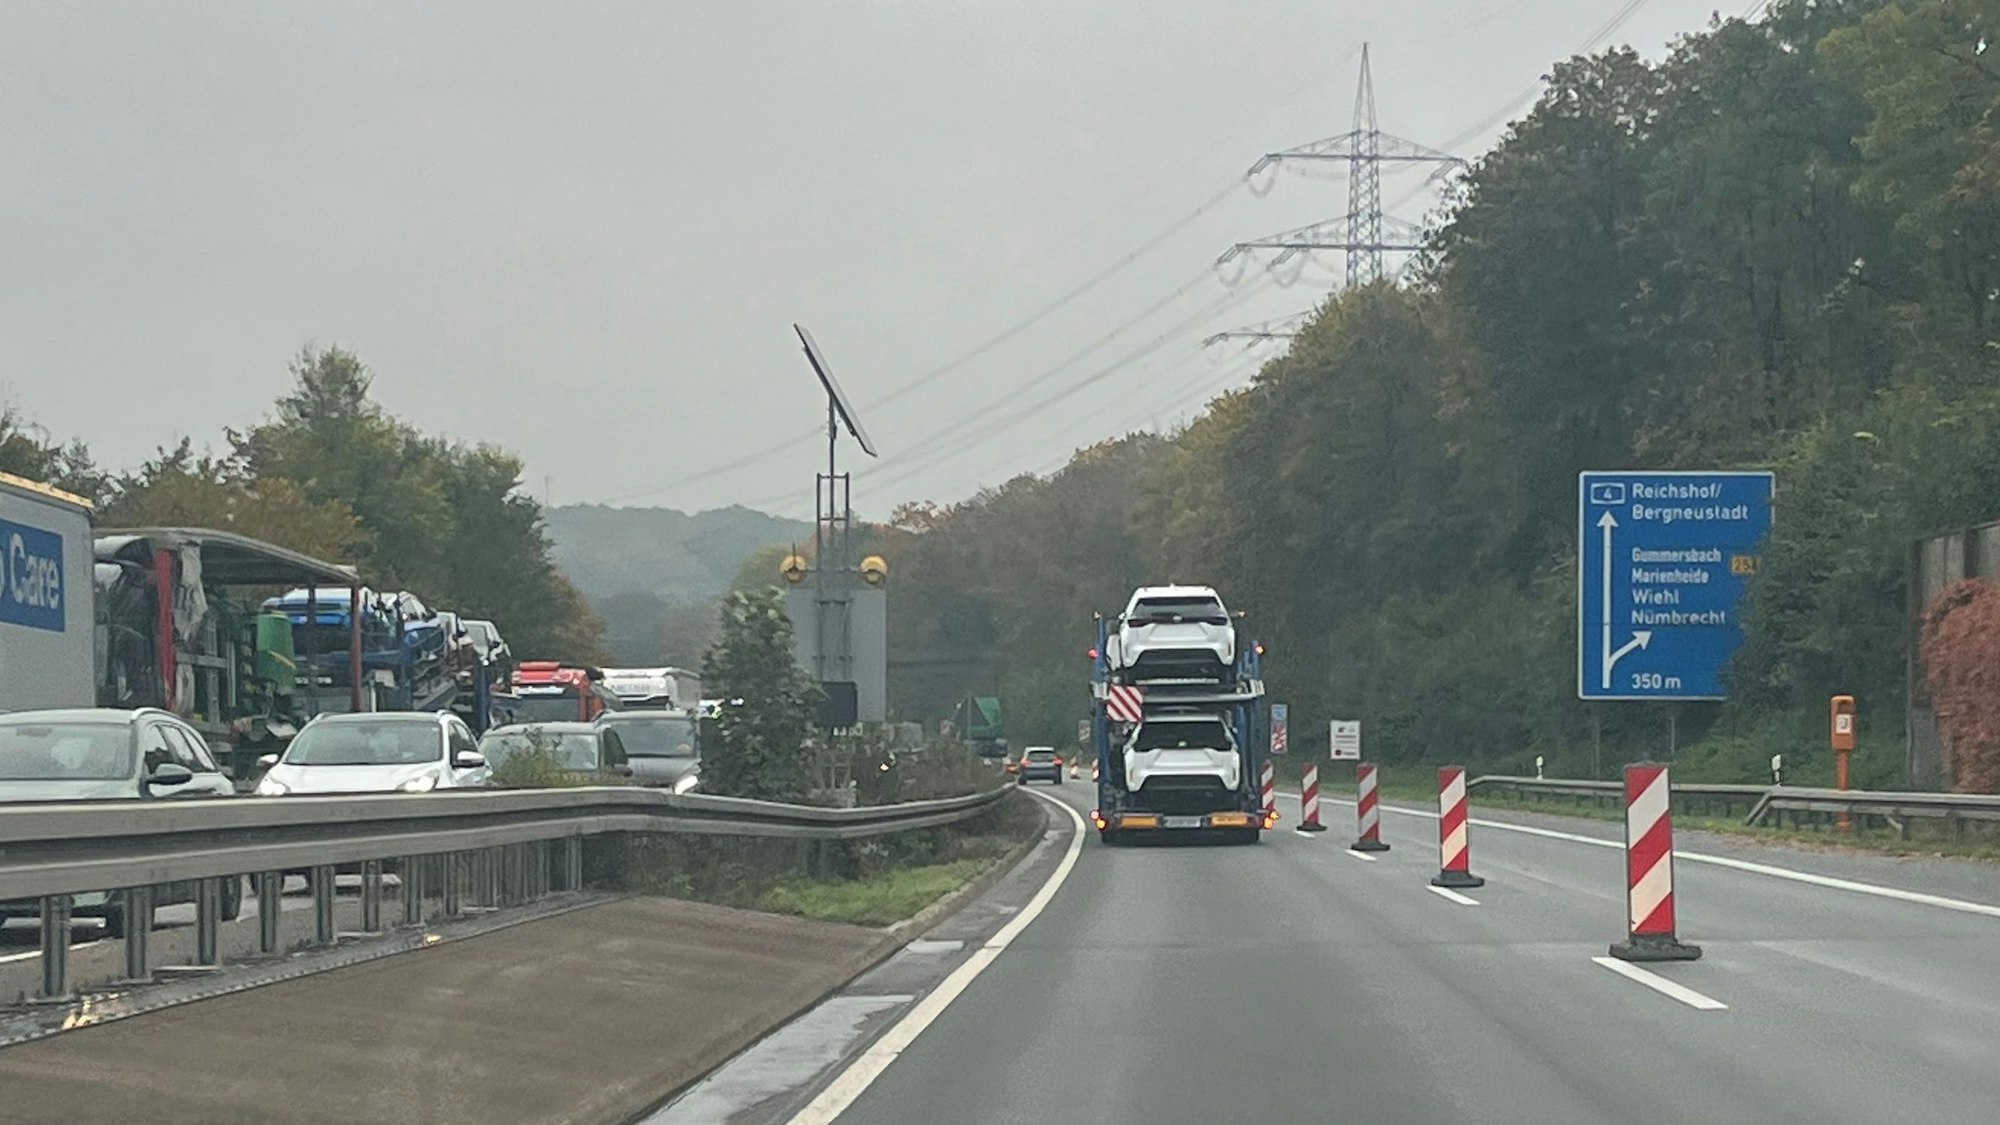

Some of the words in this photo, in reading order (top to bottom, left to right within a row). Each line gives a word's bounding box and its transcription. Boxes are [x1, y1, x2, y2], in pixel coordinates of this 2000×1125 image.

[1603, 487, 1613, 499] 4
[1632, 483, 1723, 499] Reichshof/
[1632, 504, 1749, 524] Bergneustadt
[1632, 547, 1722, 563] Gummersbach
[10, 533, 60, 609] Care
[1631, 568, 1710, 584] Marienheide
[1632, 588, 1680, 605] Wiehl
[1631, 609, 1726, 625] Nümbrecht
[1631, 674, 1662, 689] 350
[1664, 677, 1681, 689] m
